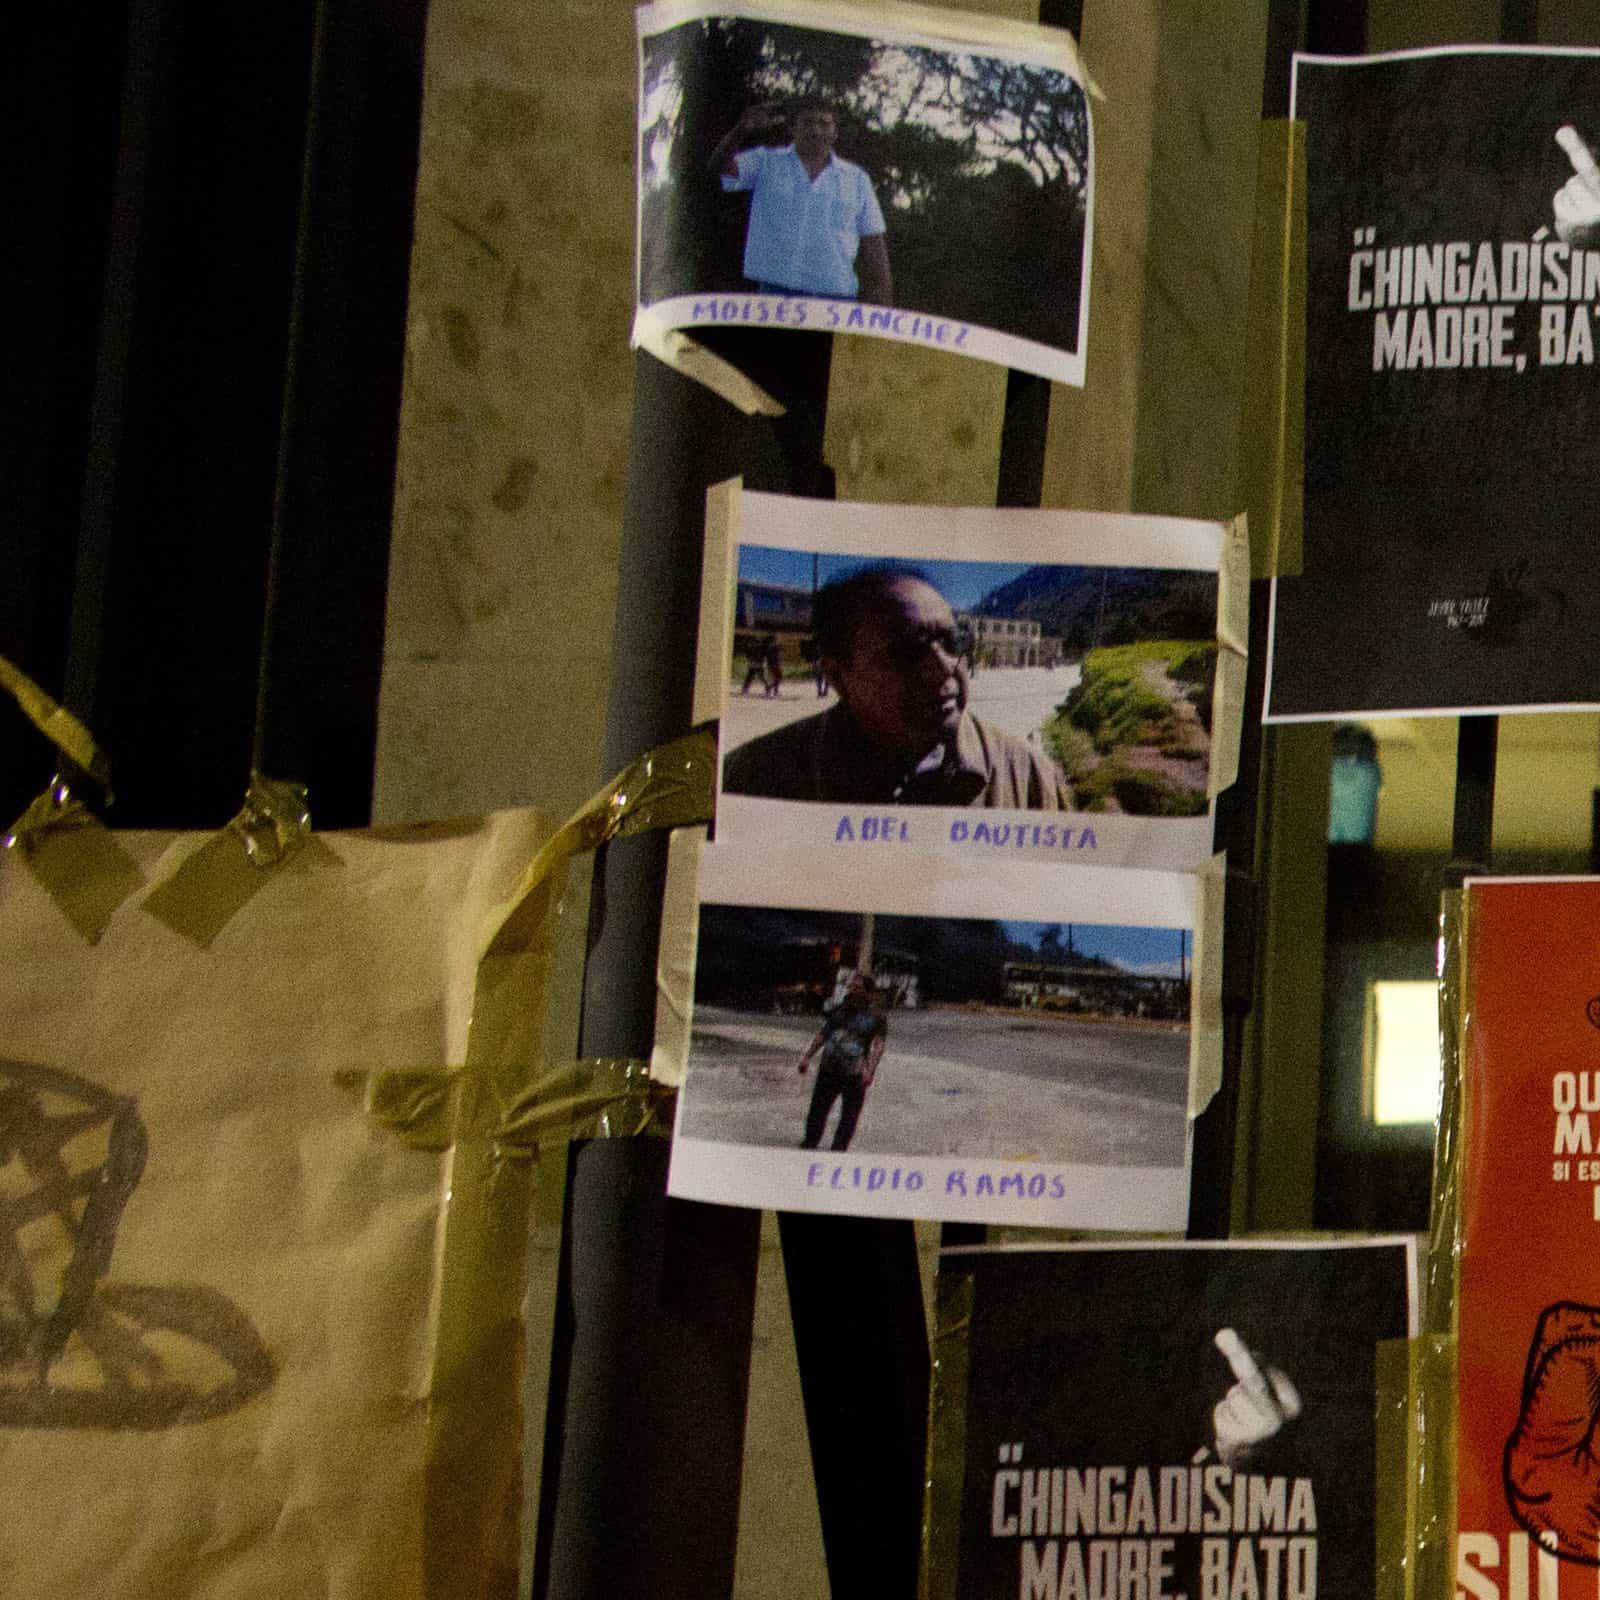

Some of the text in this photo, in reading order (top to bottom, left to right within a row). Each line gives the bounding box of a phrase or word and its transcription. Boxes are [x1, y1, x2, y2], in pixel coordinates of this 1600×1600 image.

[1373, 305, 1525, 373] MADRE,
[835, 814, 1098, 850] ABEL BAUTISTA
[946, 1171, 1067, 1199] RAMOS
[1552, 1161, 1570, 1181] SI
